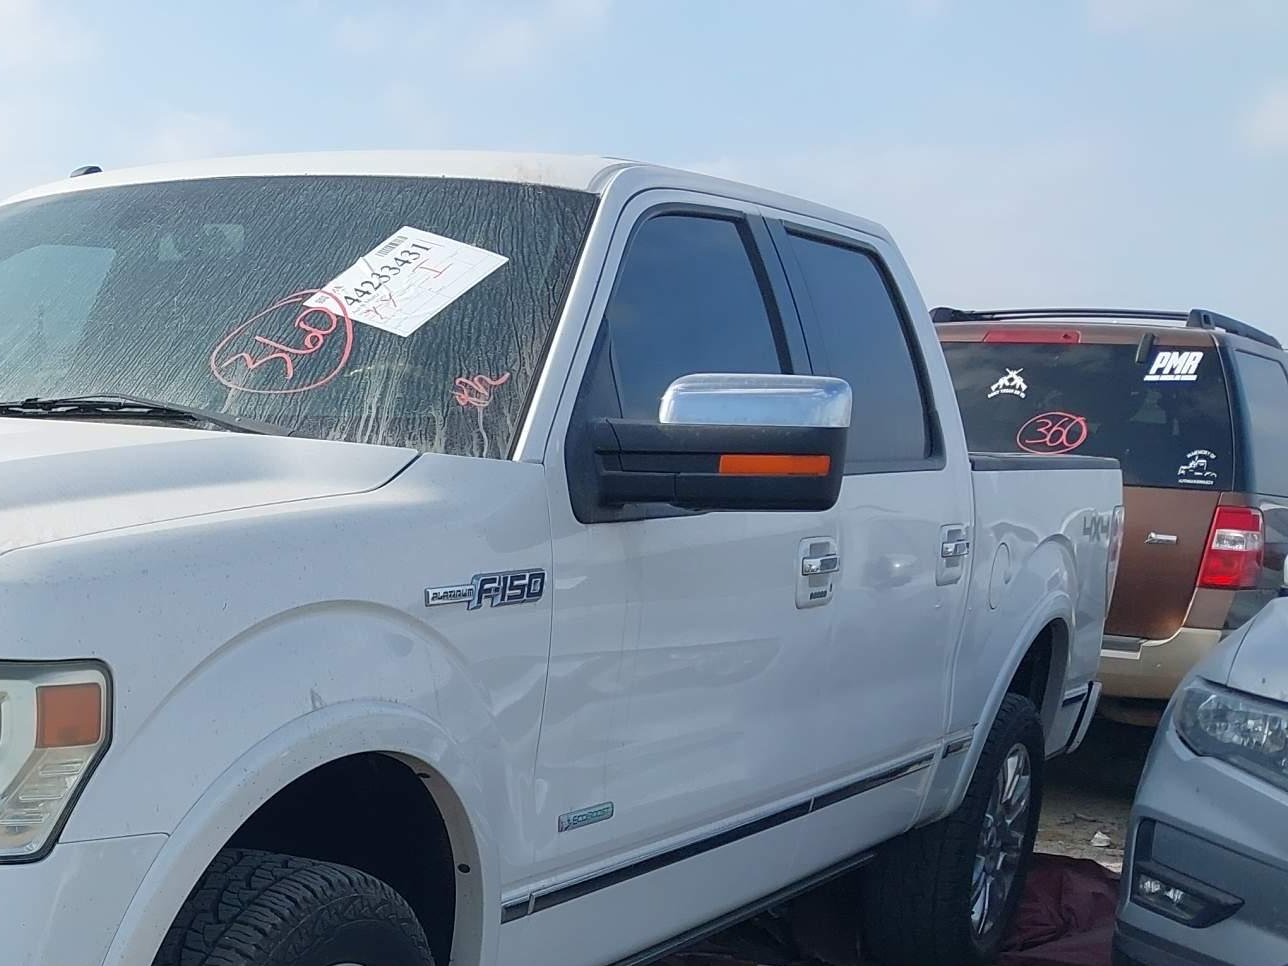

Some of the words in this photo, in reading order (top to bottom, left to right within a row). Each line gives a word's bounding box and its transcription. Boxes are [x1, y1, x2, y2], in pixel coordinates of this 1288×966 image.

[344, 243, 431, 306] 44233431
[220, 306, 338, 381] 360
[1025, 416, 1087, 448] 360
[431, 588, 473, 601] PLATINUM
